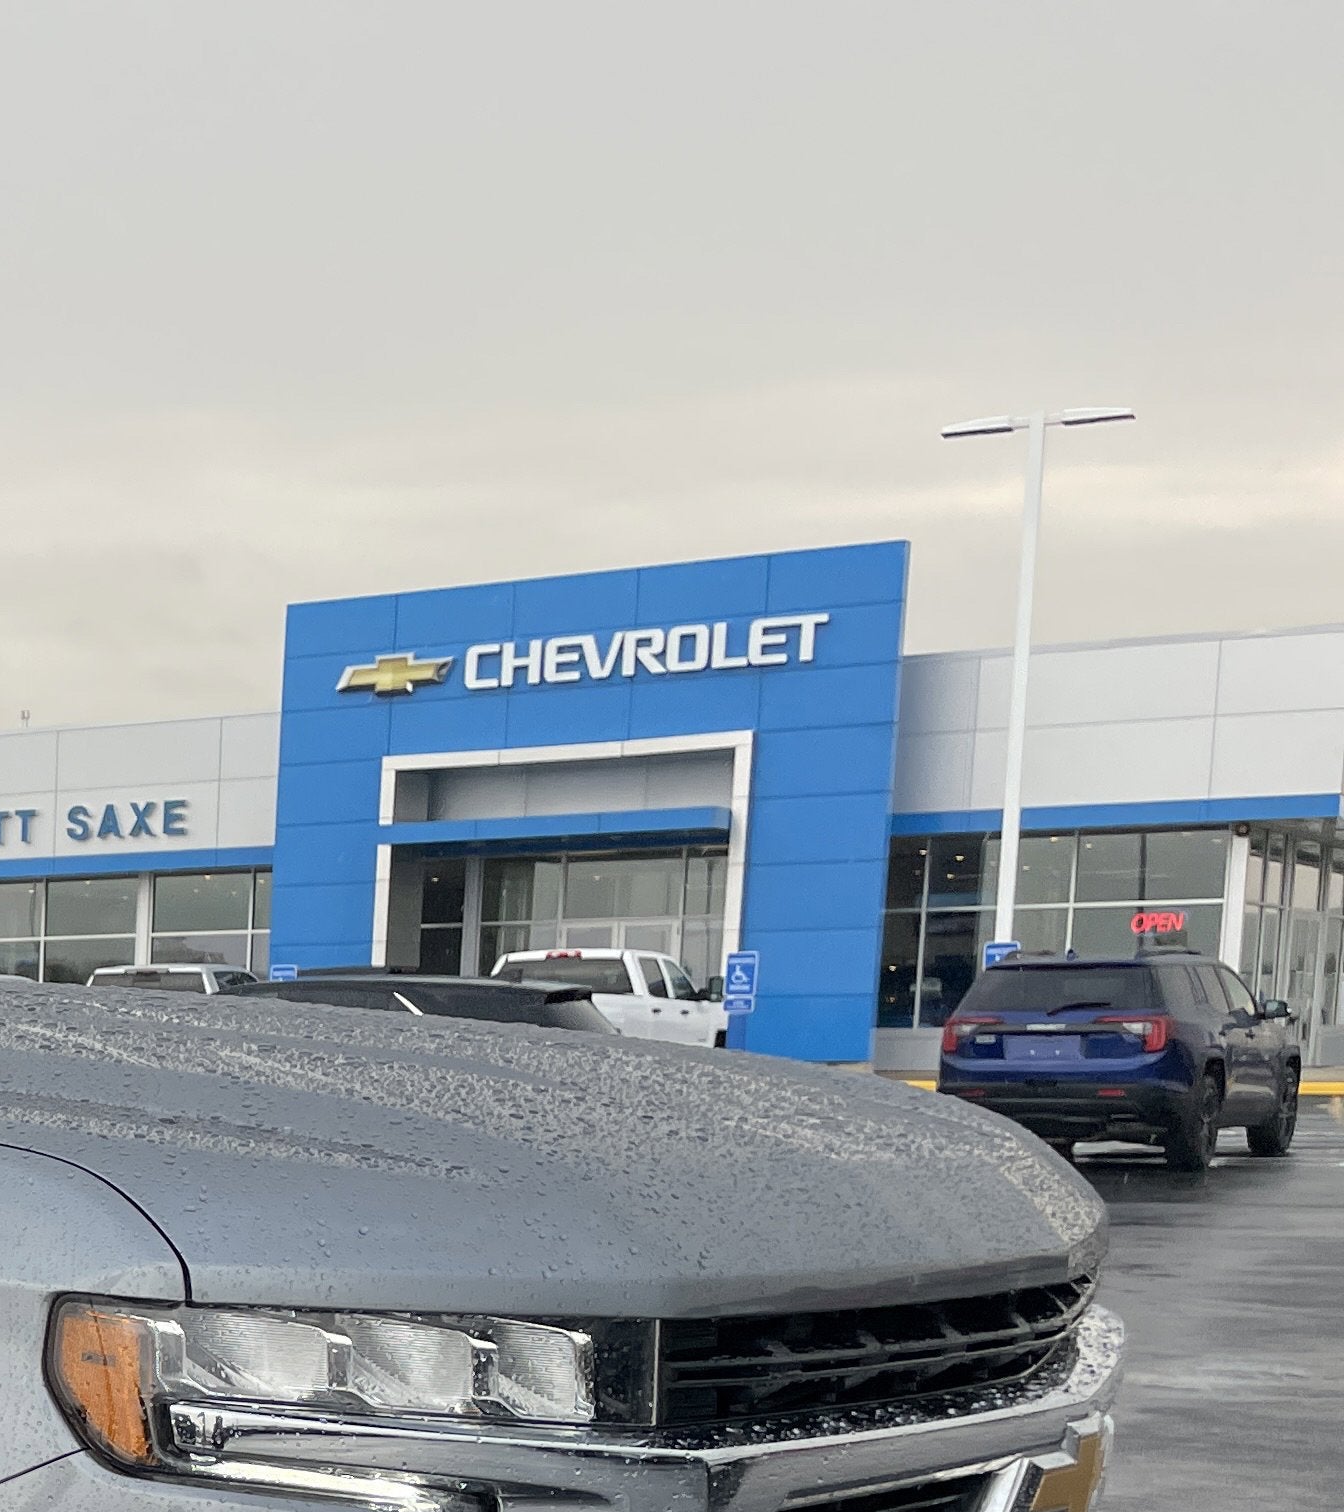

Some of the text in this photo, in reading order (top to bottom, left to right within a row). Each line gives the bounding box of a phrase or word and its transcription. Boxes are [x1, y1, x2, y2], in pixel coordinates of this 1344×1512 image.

[463, 612, 830, 690] CHEVROLET
[66, 799, 188, 842] SAXE
[1130, 911, 1184, 935] OPEN
